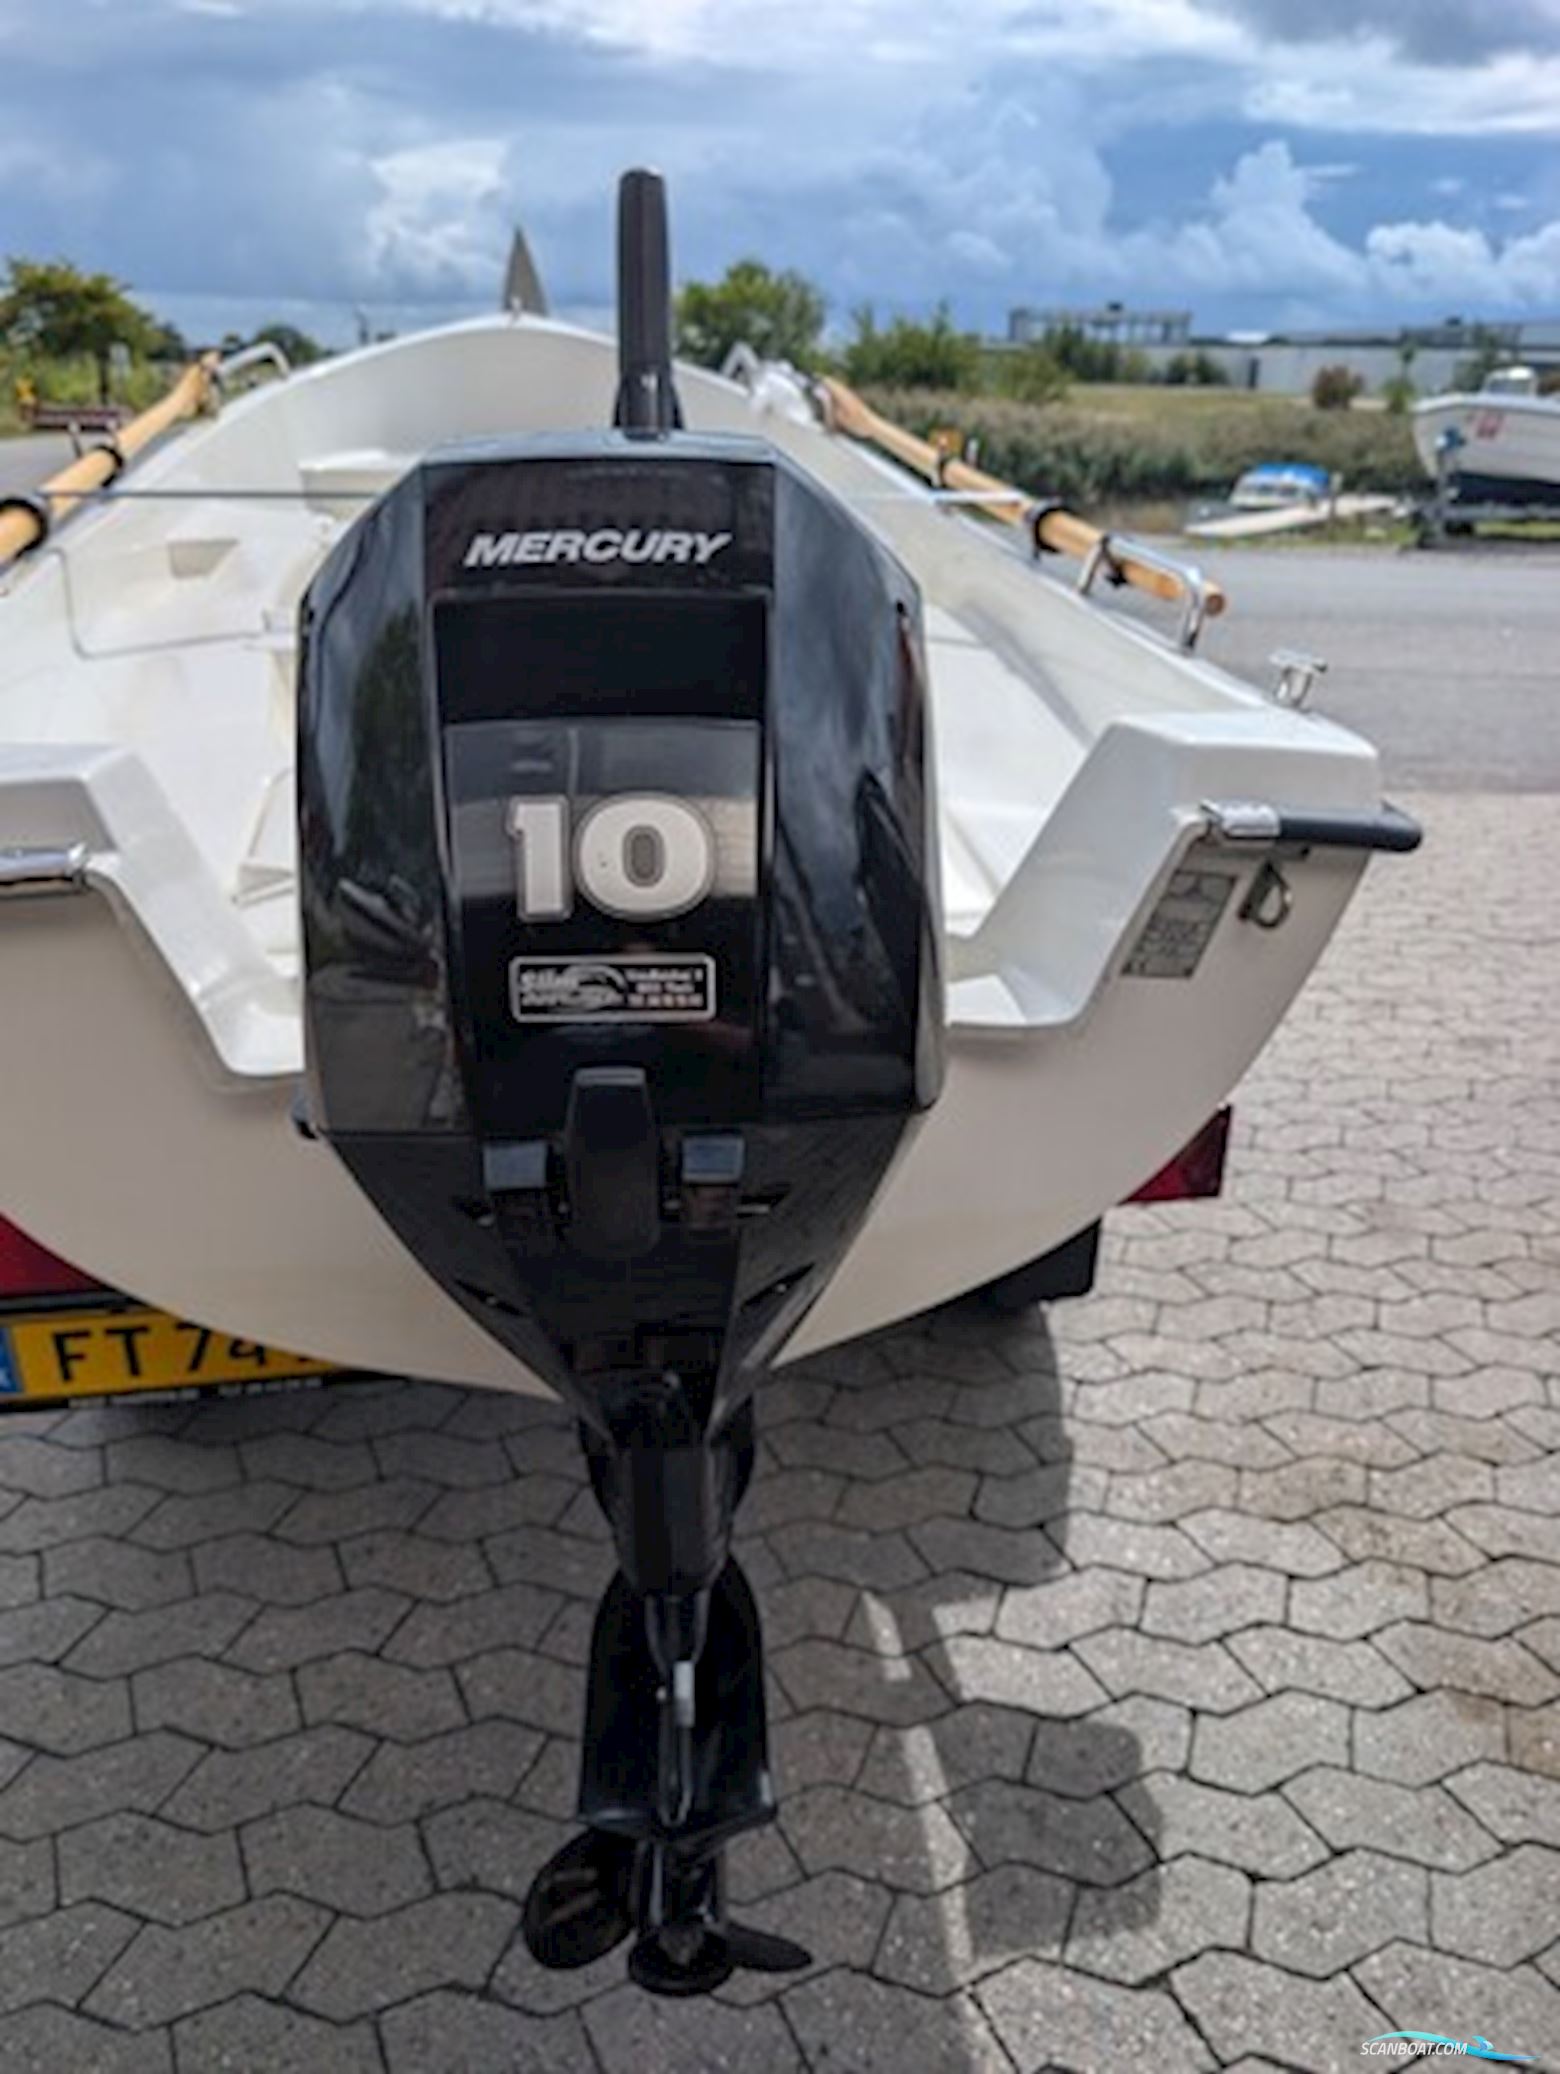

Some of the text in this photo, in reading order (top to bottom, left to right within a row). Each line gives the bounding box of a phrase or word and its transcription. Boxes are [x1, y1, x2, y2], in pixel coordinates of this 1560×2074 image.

[463, 529, 733, 568] MERCURY
[505, 790, 717, 922] 10
[53, 1325, 149, 1382] FT
